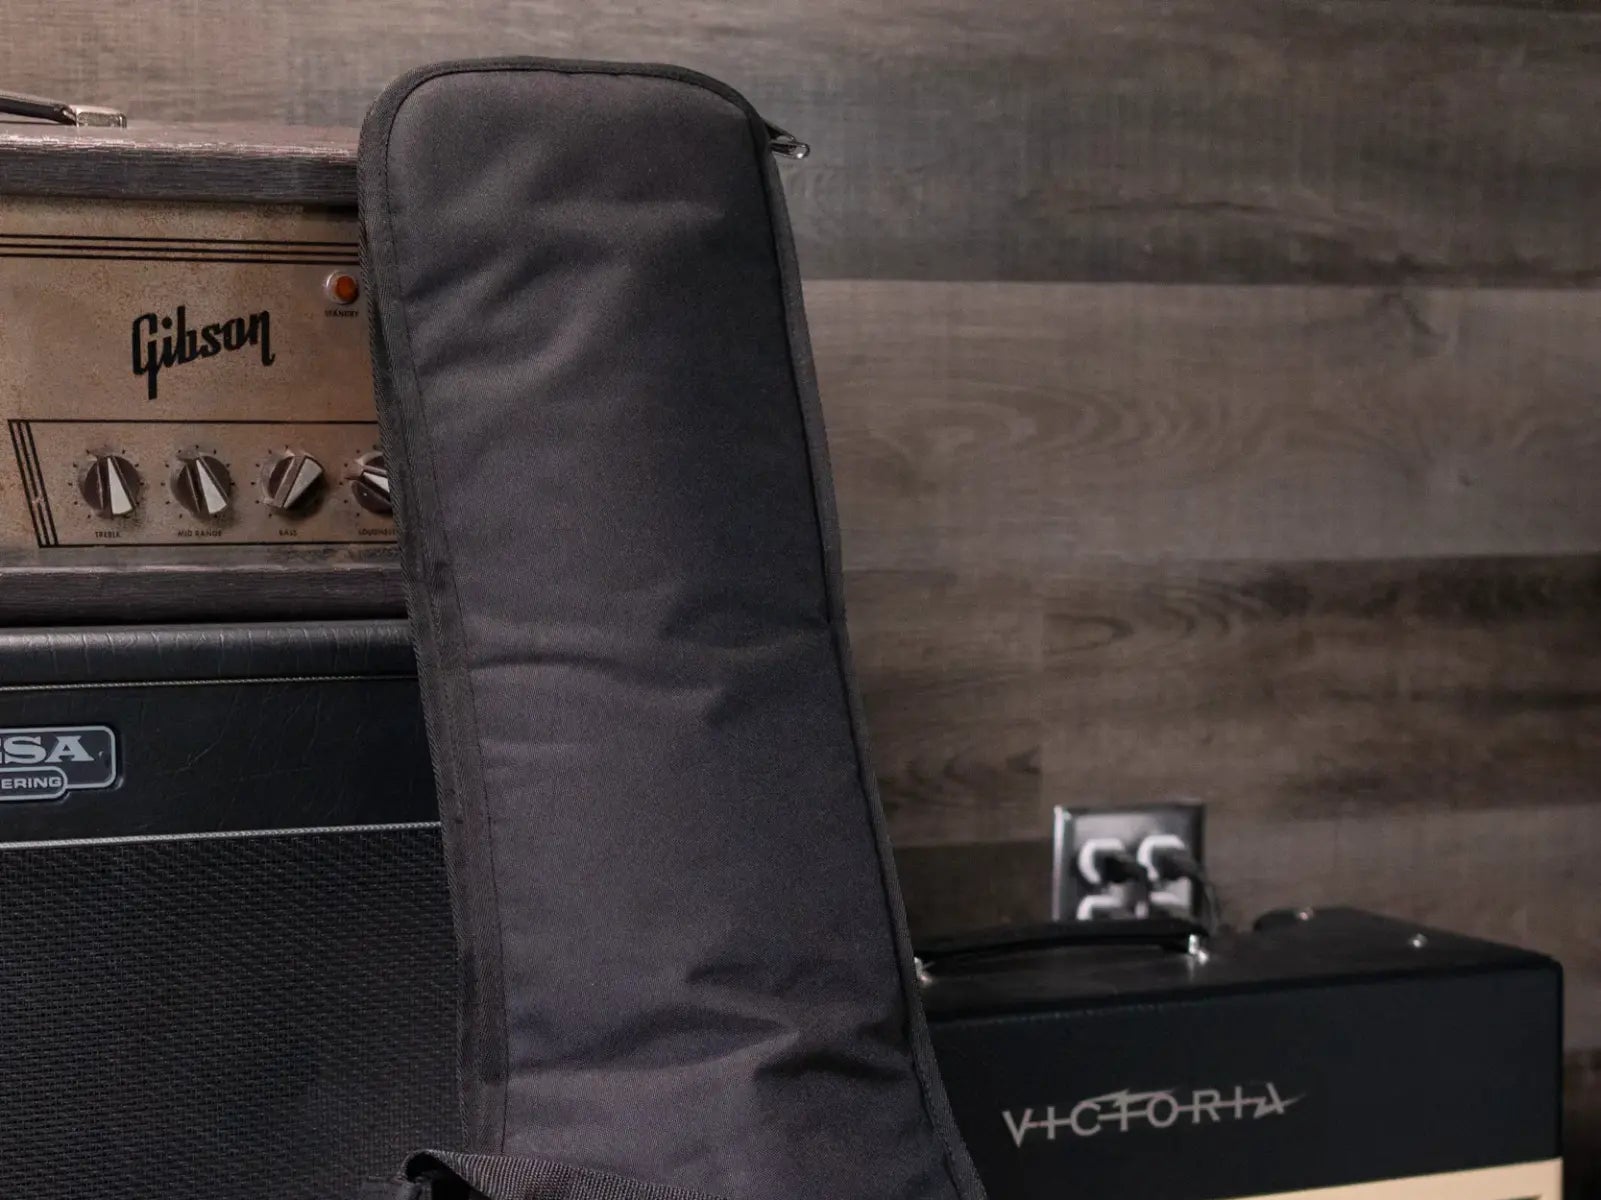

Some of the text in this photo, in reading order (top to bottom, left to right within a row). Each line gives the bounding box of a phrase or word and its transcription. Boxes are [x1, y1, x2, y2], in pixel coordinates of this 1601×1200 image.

[132, 305, 275, 400] Gibson
[0, 735, 95, 764] SA
[1002, 1081, 1292, 1148] VICTORIA
